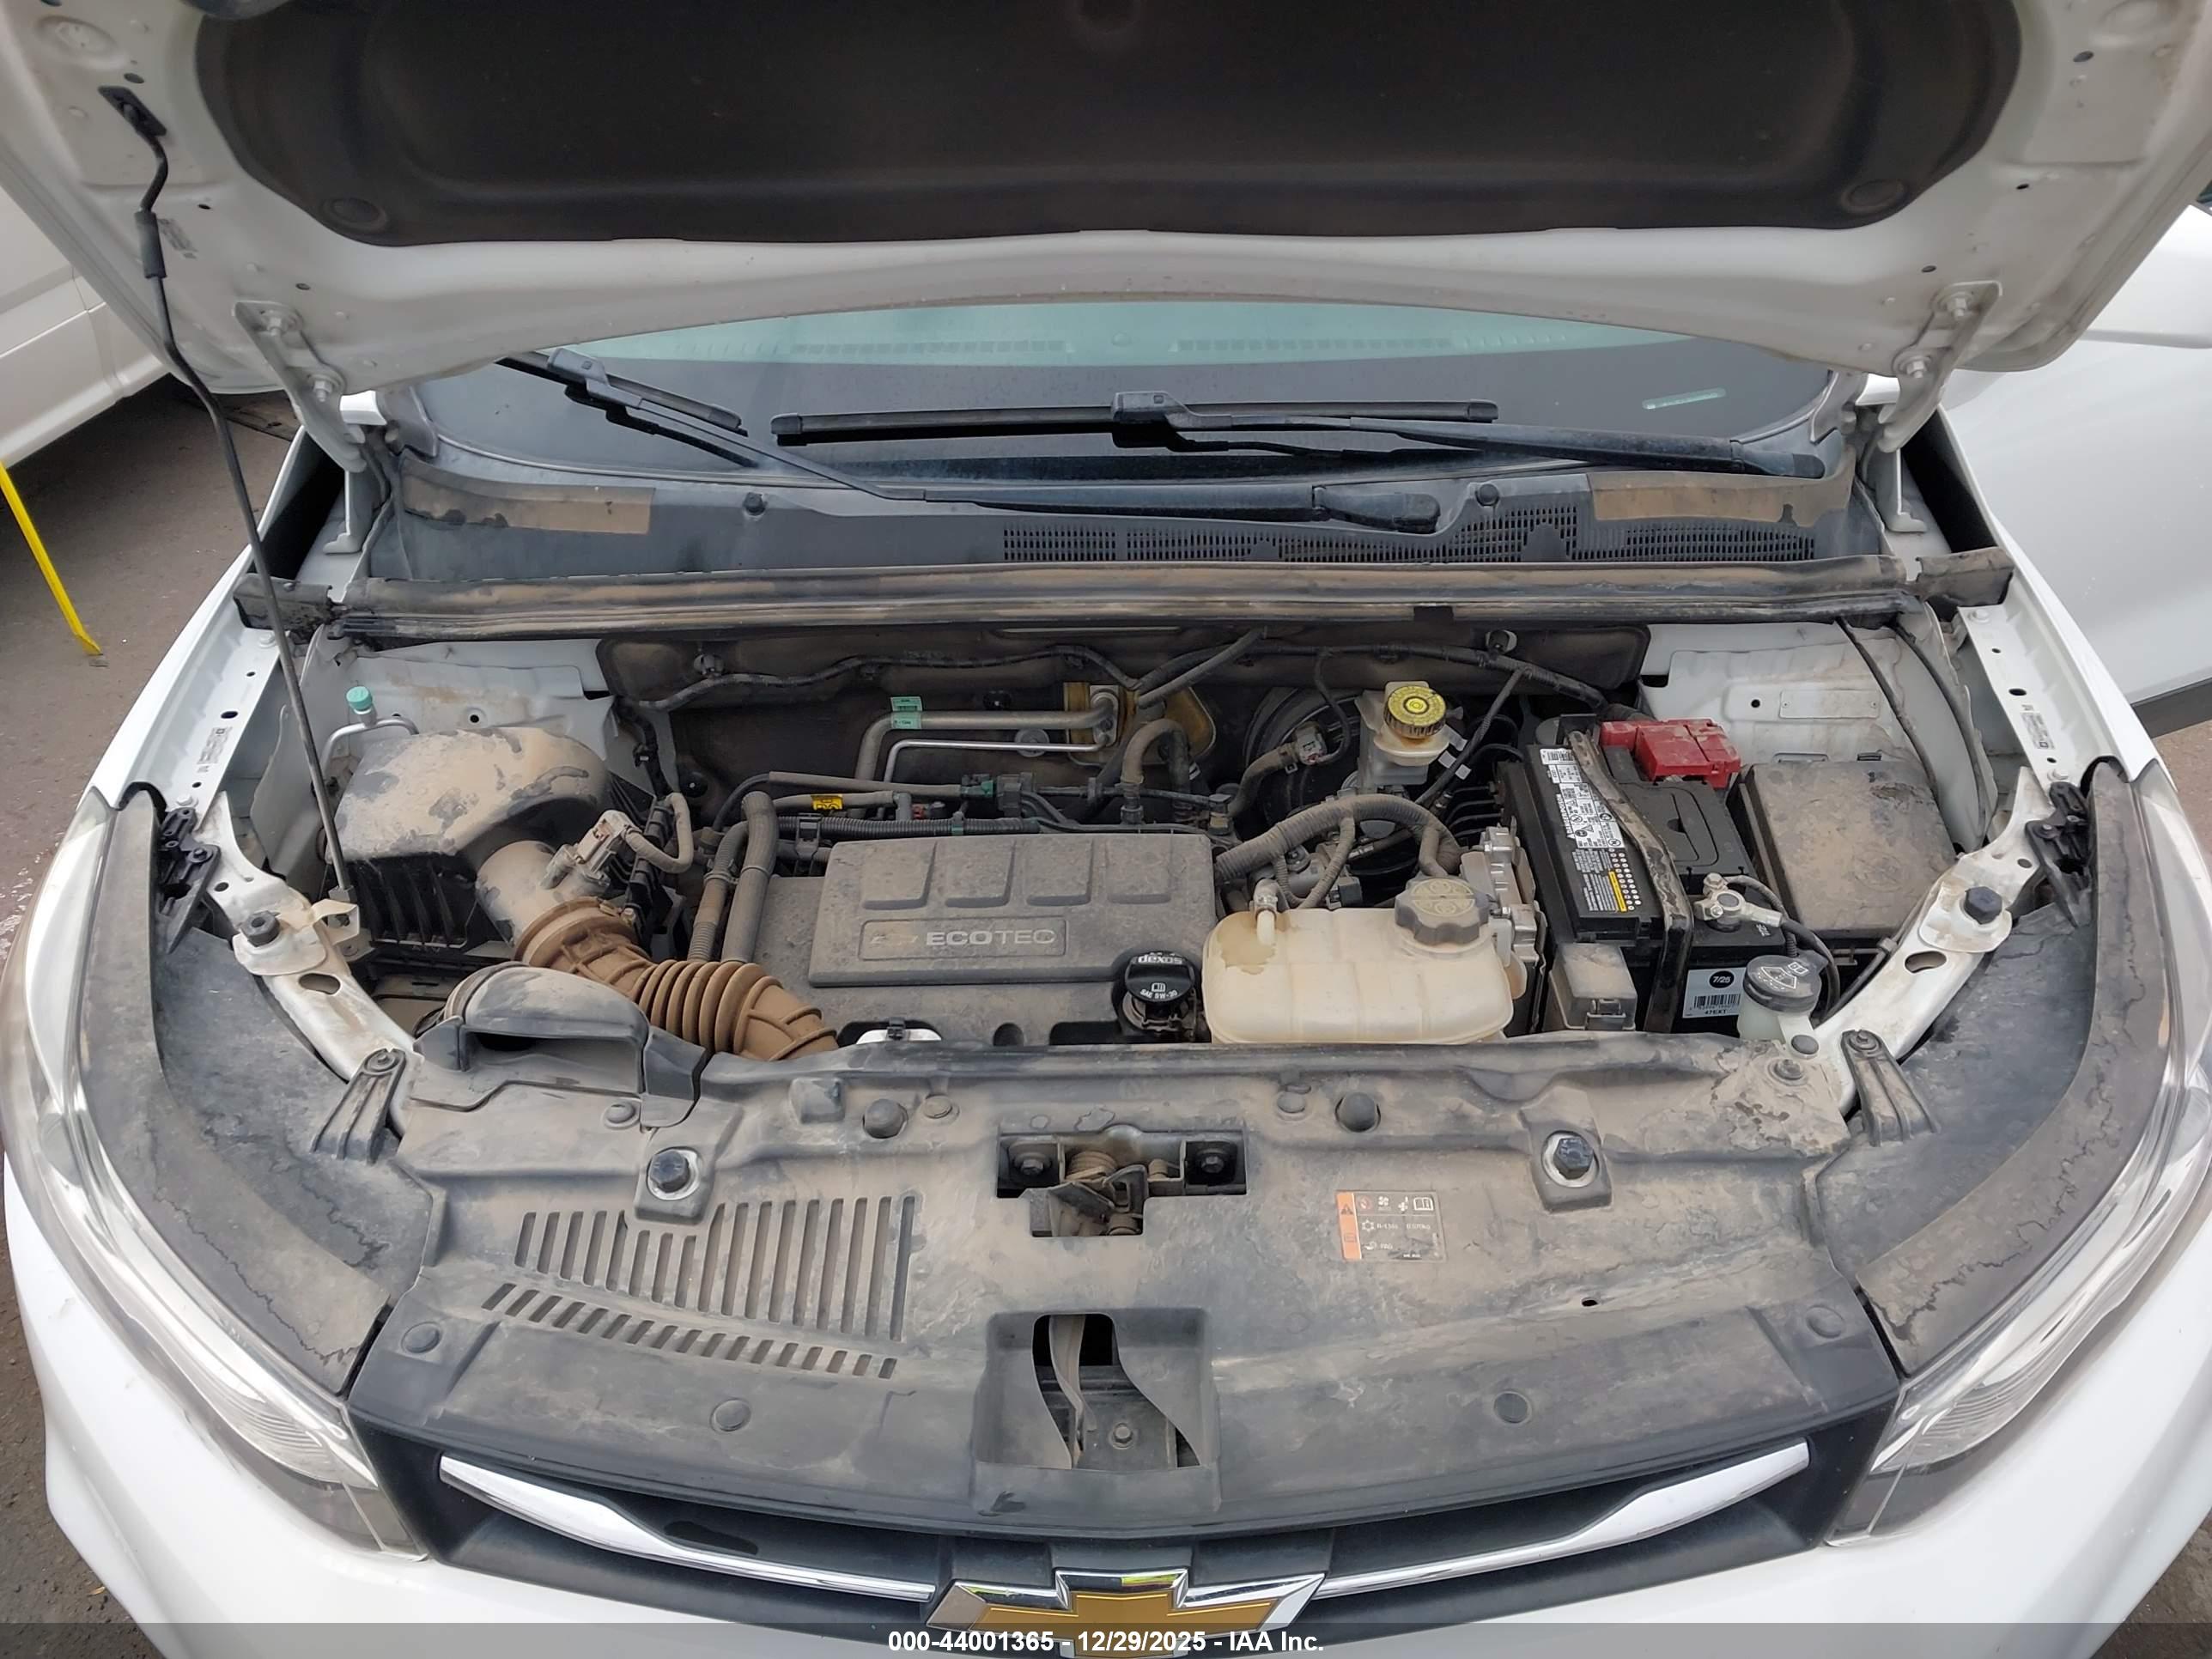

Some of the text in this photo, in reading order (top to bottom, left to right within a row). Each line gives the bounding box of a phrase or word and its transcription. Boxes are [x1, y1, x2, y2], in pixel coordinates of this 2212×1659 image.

[927, 929, 1055, 945] ECOTEC
[1138, 954, 1182, 964] dexos
[1139, 988, 1153, 999] SAE
